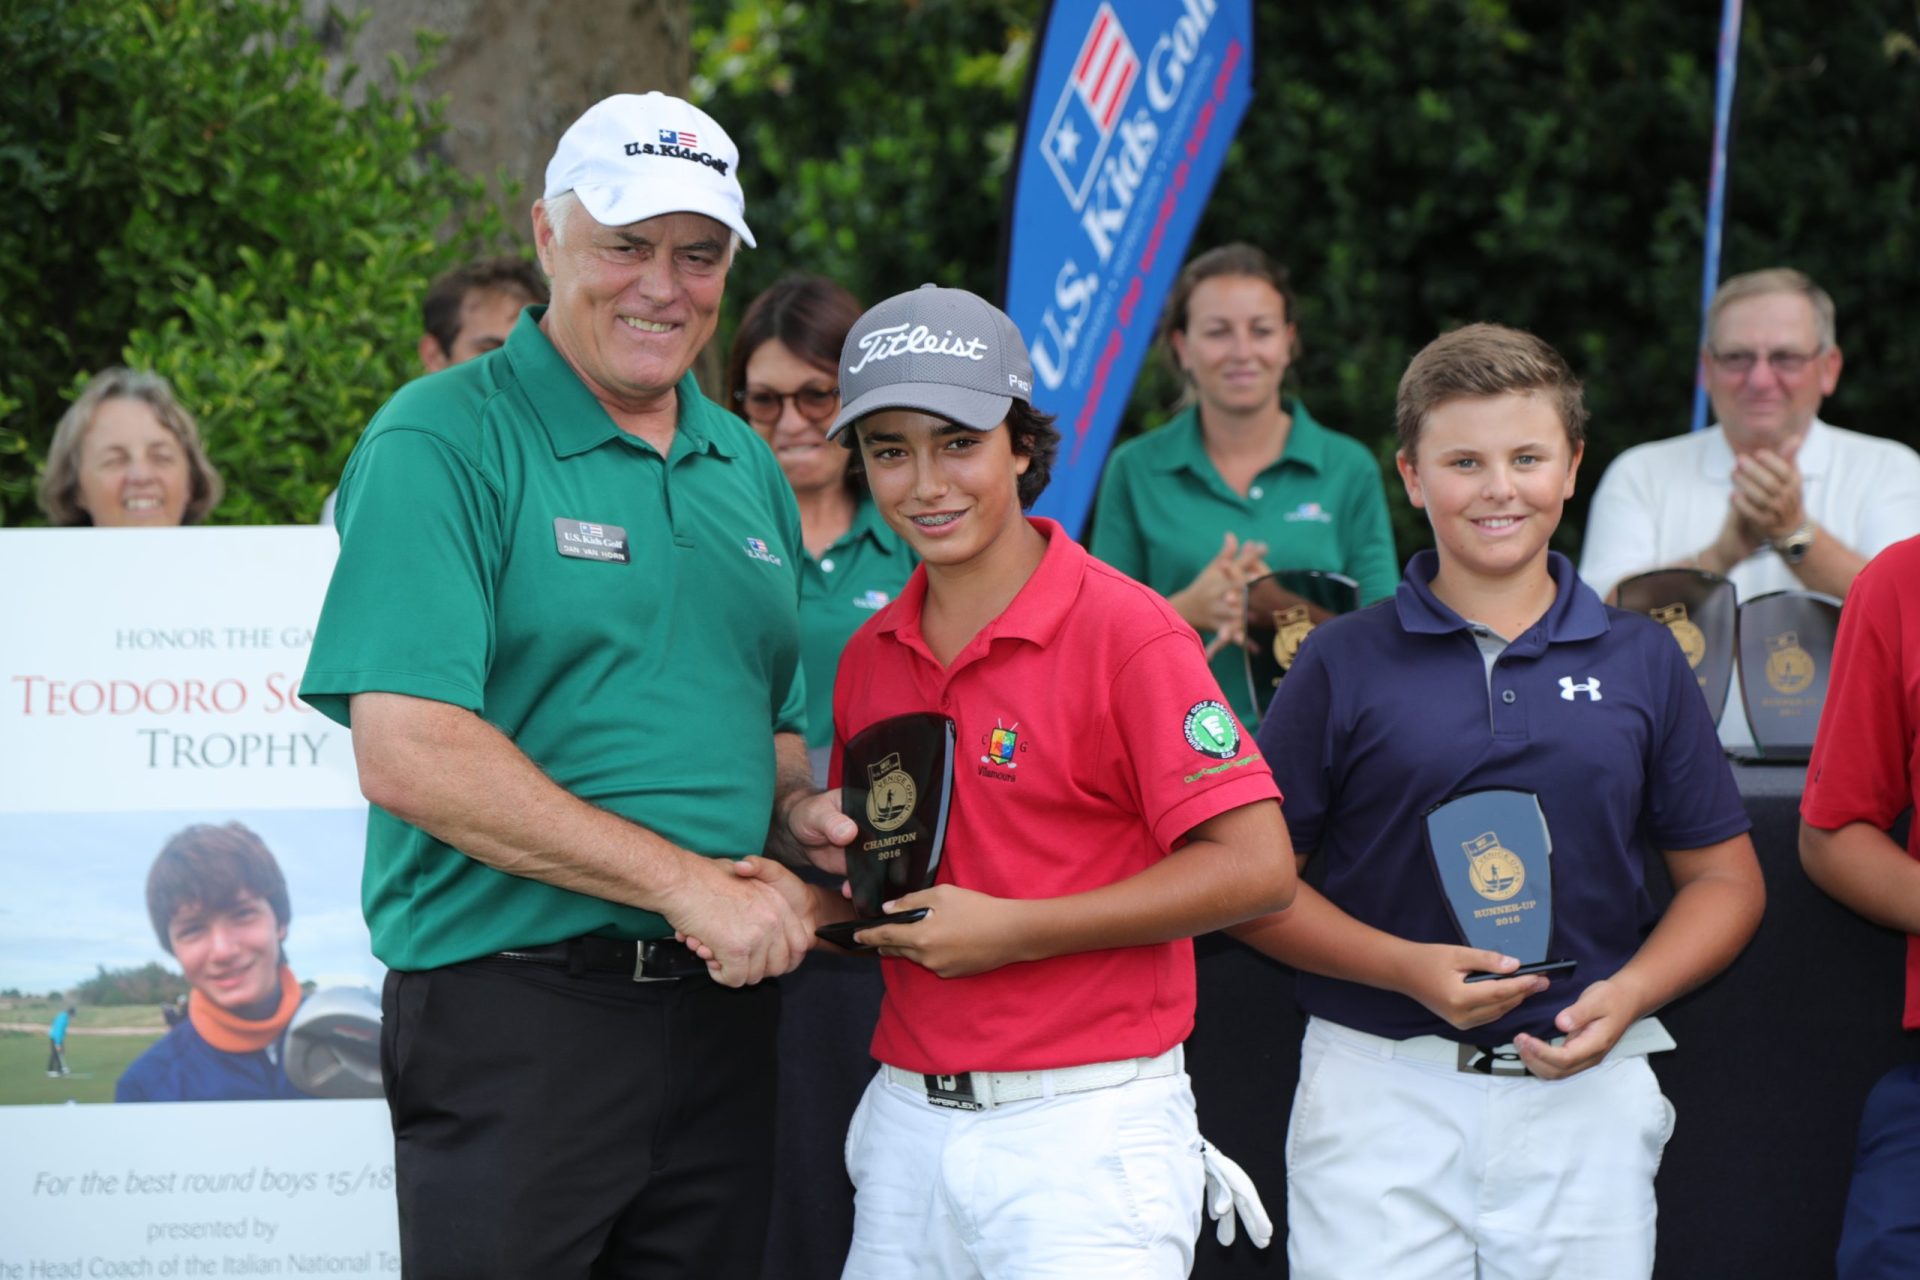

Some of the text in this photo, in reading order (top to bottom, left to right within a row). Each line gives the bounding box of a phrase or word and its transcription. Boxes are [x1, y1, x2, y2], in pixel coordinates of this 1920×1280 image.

[1030, 257, 1098, 391] U.S.
[1082, 108, 1159, 262] Kids
[849, 322, 988, 375] Titleist
[564, 532, 624, 549] U.S. Kids Golf
[582, 548, 599, 556] VAN
[601, 551, 625, 561] HORN
[115, 627, 215, 650] HONOR
[220, 626, 273, 649] THE
[12, 675, 248, 716] TEODORO
[1190, 701, 1209, 714] GOLF
[137, 728, 329, 769] TROPHY
[877, 775, 914, 812] VENICE OPEN
[863, 832, 917, 851] CHAMPION
[878, 849, 901, 860] 2016
[1473, 900, 1537, 918] RUNNER-UP
[1496, 915, 1520, 926] 2016
[33, 1162, 394, 1198] For the best round boys 15/18
[147, 1216, 279, 1244] presented by
[30, 1256, 82, 1280] Head
[88, 1255, 152, 1279] Coach
[158, 1253, 181, 1277] of
[186, 1253, 218, 1277] the
[223, 1252, 282, 1275] Italian
[288, 1250, 369, 1274] National
